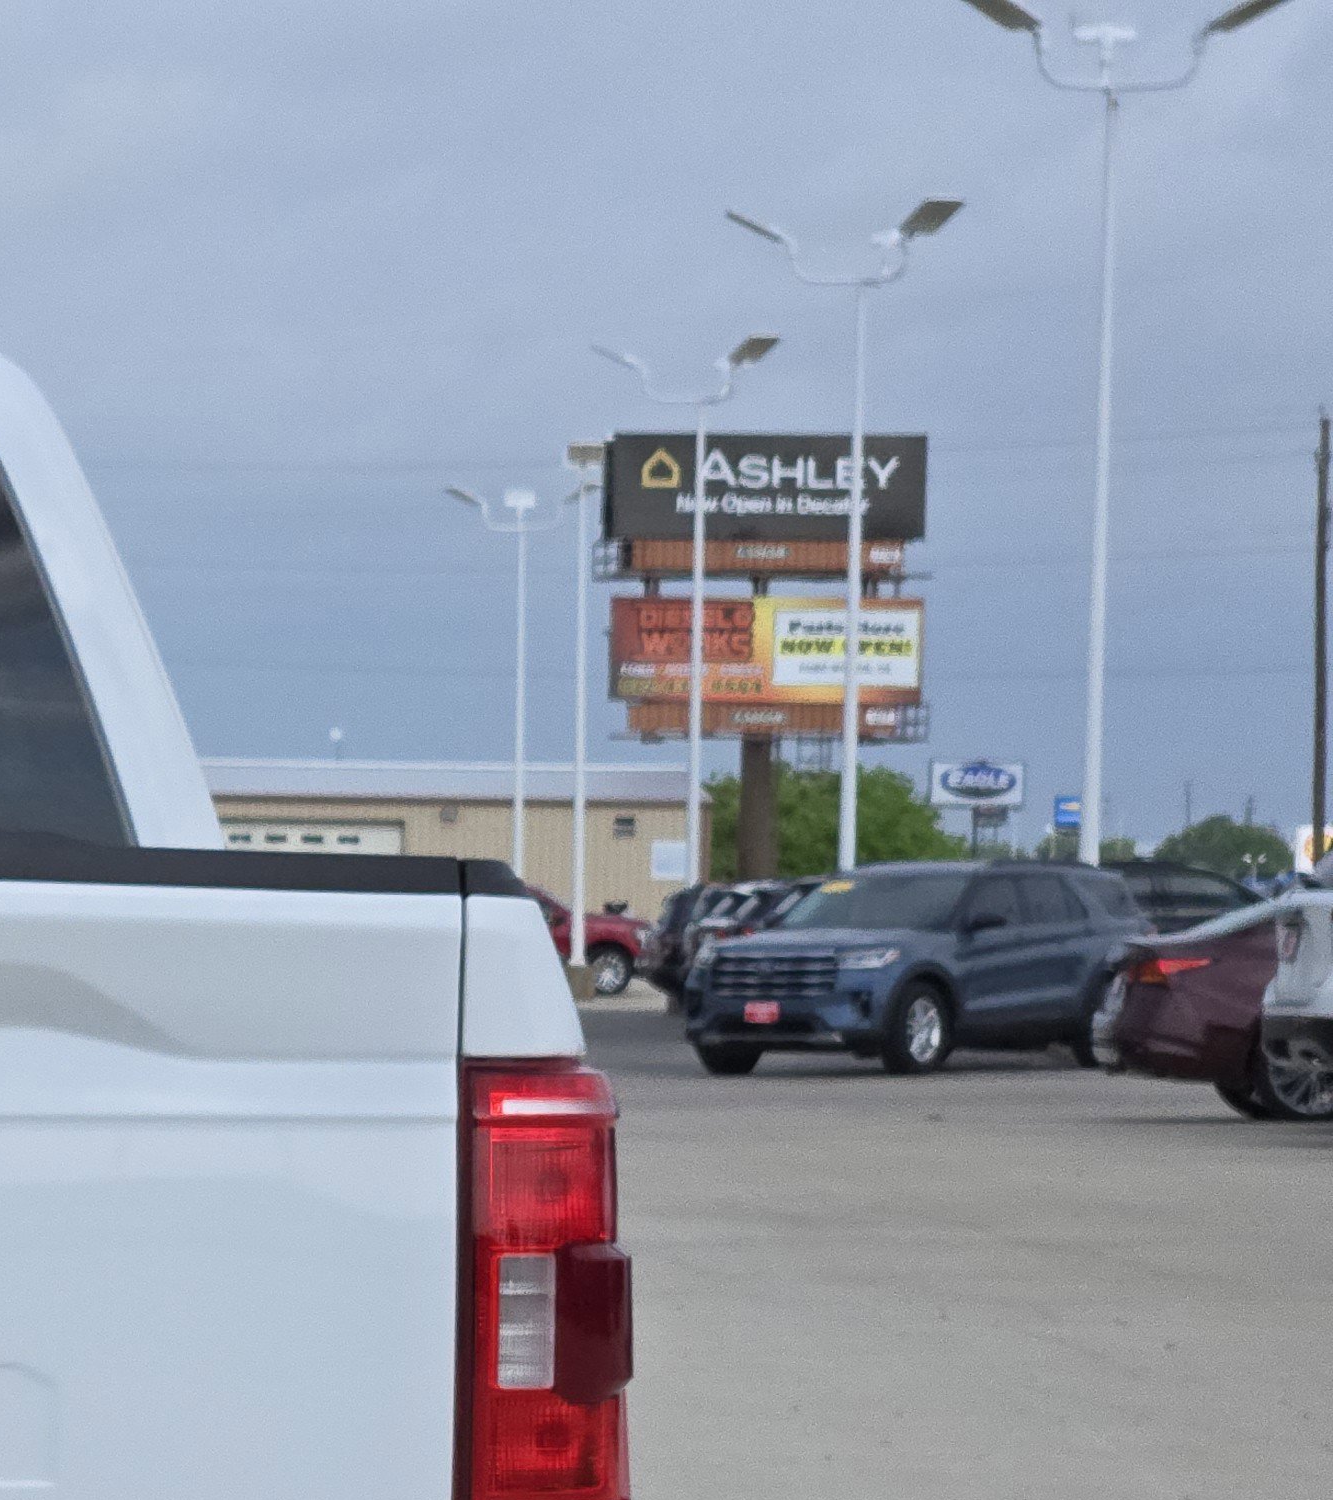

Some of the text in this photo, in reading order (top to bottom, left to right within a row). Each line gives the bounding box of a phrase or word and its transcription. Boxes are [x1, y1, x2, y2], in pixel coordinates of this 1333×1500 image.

[701, 448, 901, 490] ASHLEY
[676, 492, 718, 513] Nw
[841, 639, 912, 656] PEN!
